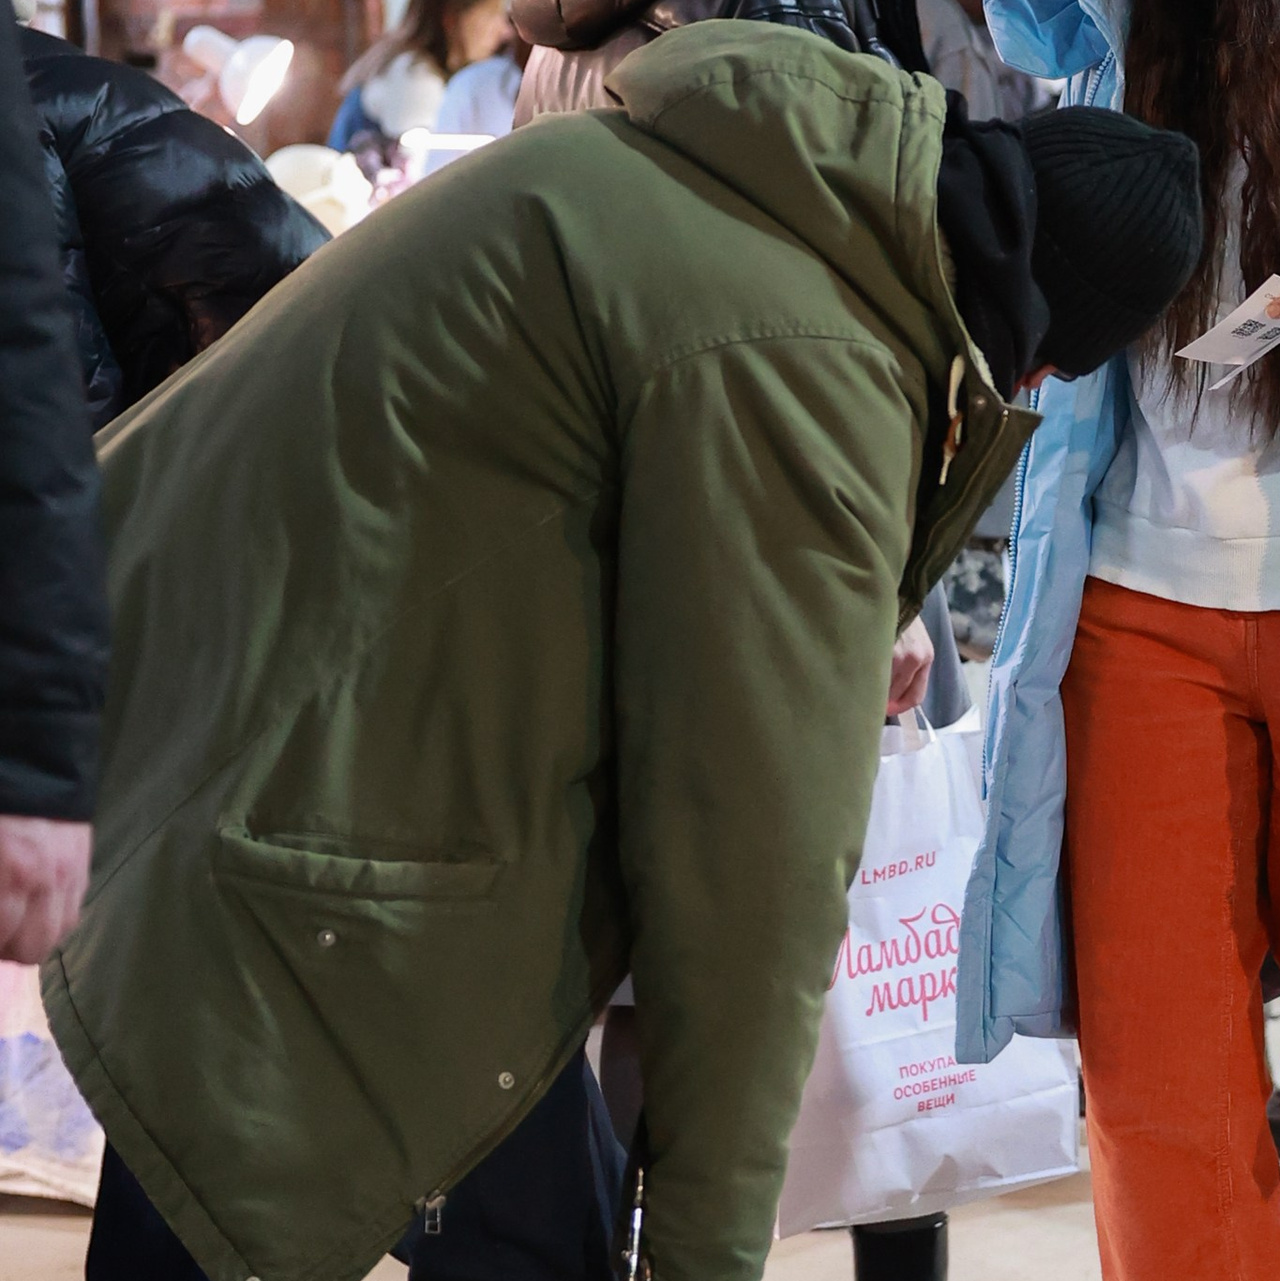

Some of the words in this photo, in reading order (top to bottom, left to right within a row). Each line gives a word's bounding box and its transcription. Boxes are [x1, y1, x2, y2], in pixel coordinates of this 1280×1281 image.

[862, 851, 936, 885] LMBD.RU
[827, 903, 960, 991] Ламбад
[865, 966, 956, 1022] марк
[899, 1055, 956, 1079] ПОКУПА
[893, 1069, 976, 1100] ОСОБЕННЫЕ
[917, 1093, 955, 1112] ВЕЩИ
